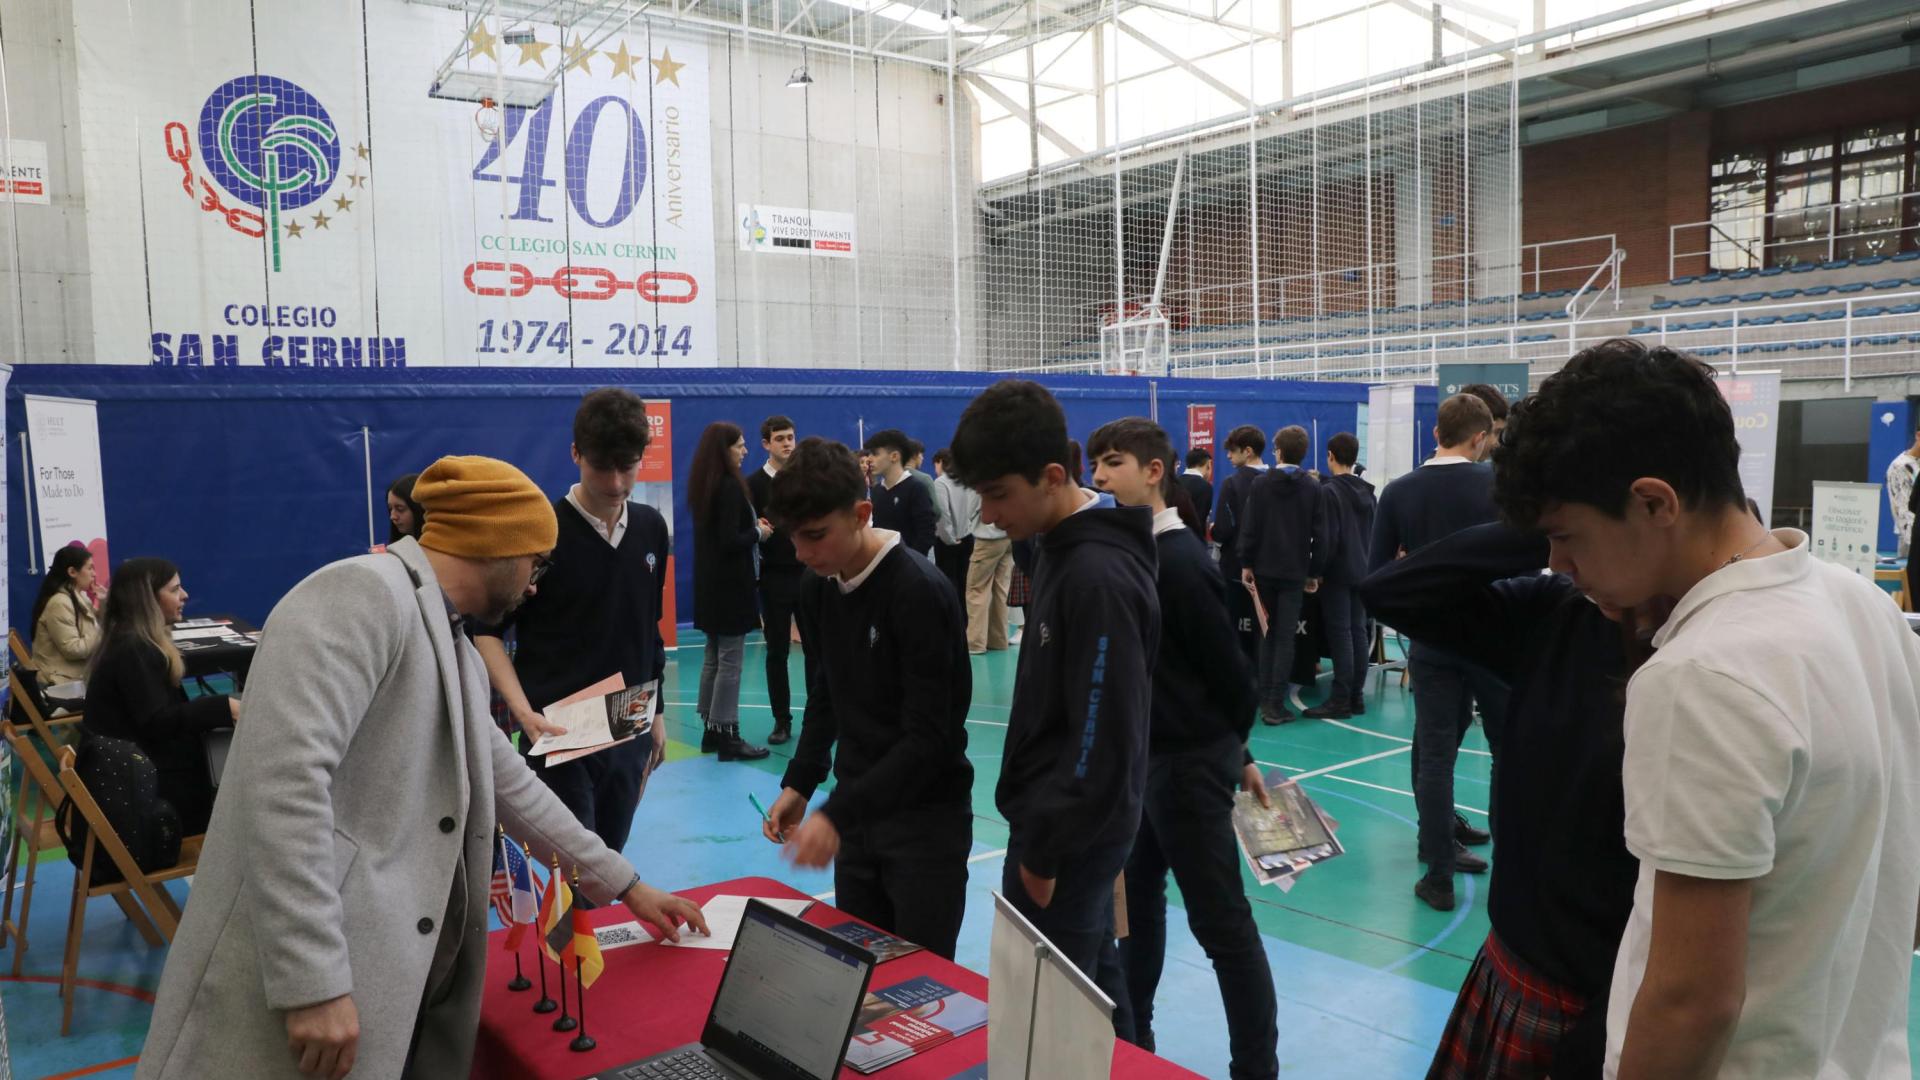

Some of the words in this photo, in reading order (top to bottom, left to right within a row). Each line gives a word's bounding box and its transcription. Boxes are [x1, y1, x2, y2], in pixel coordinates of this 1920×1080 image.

[472, 89, 647, 228] 40
[659, 106, 684, 231] Aniversario
[481, 235, 566, 254] COLEGIO
[573, 241, 607, 256] SAN
[613, 242, 677, 260] CERNIN
[772, 226, 788, 236] VIVE
[224, 304, 337, 328] COLEGIO
[150, 332, 239, 366] SAN
[262, 335, 406, 367] CERNIN
[476, 319, 569, 354] 1974
[605, 323, 692, 356] 2014
[40, 467, 52, 480] For
[53, 467, 75, 480] Those
[42, 484, 63, 499] Made
[65, 487, 72, 497] to
[73, 485, 84, 497] Do
[1091, 636, 1108, 684] SAN
[1075, 688, 1102, 778] CERNIN
